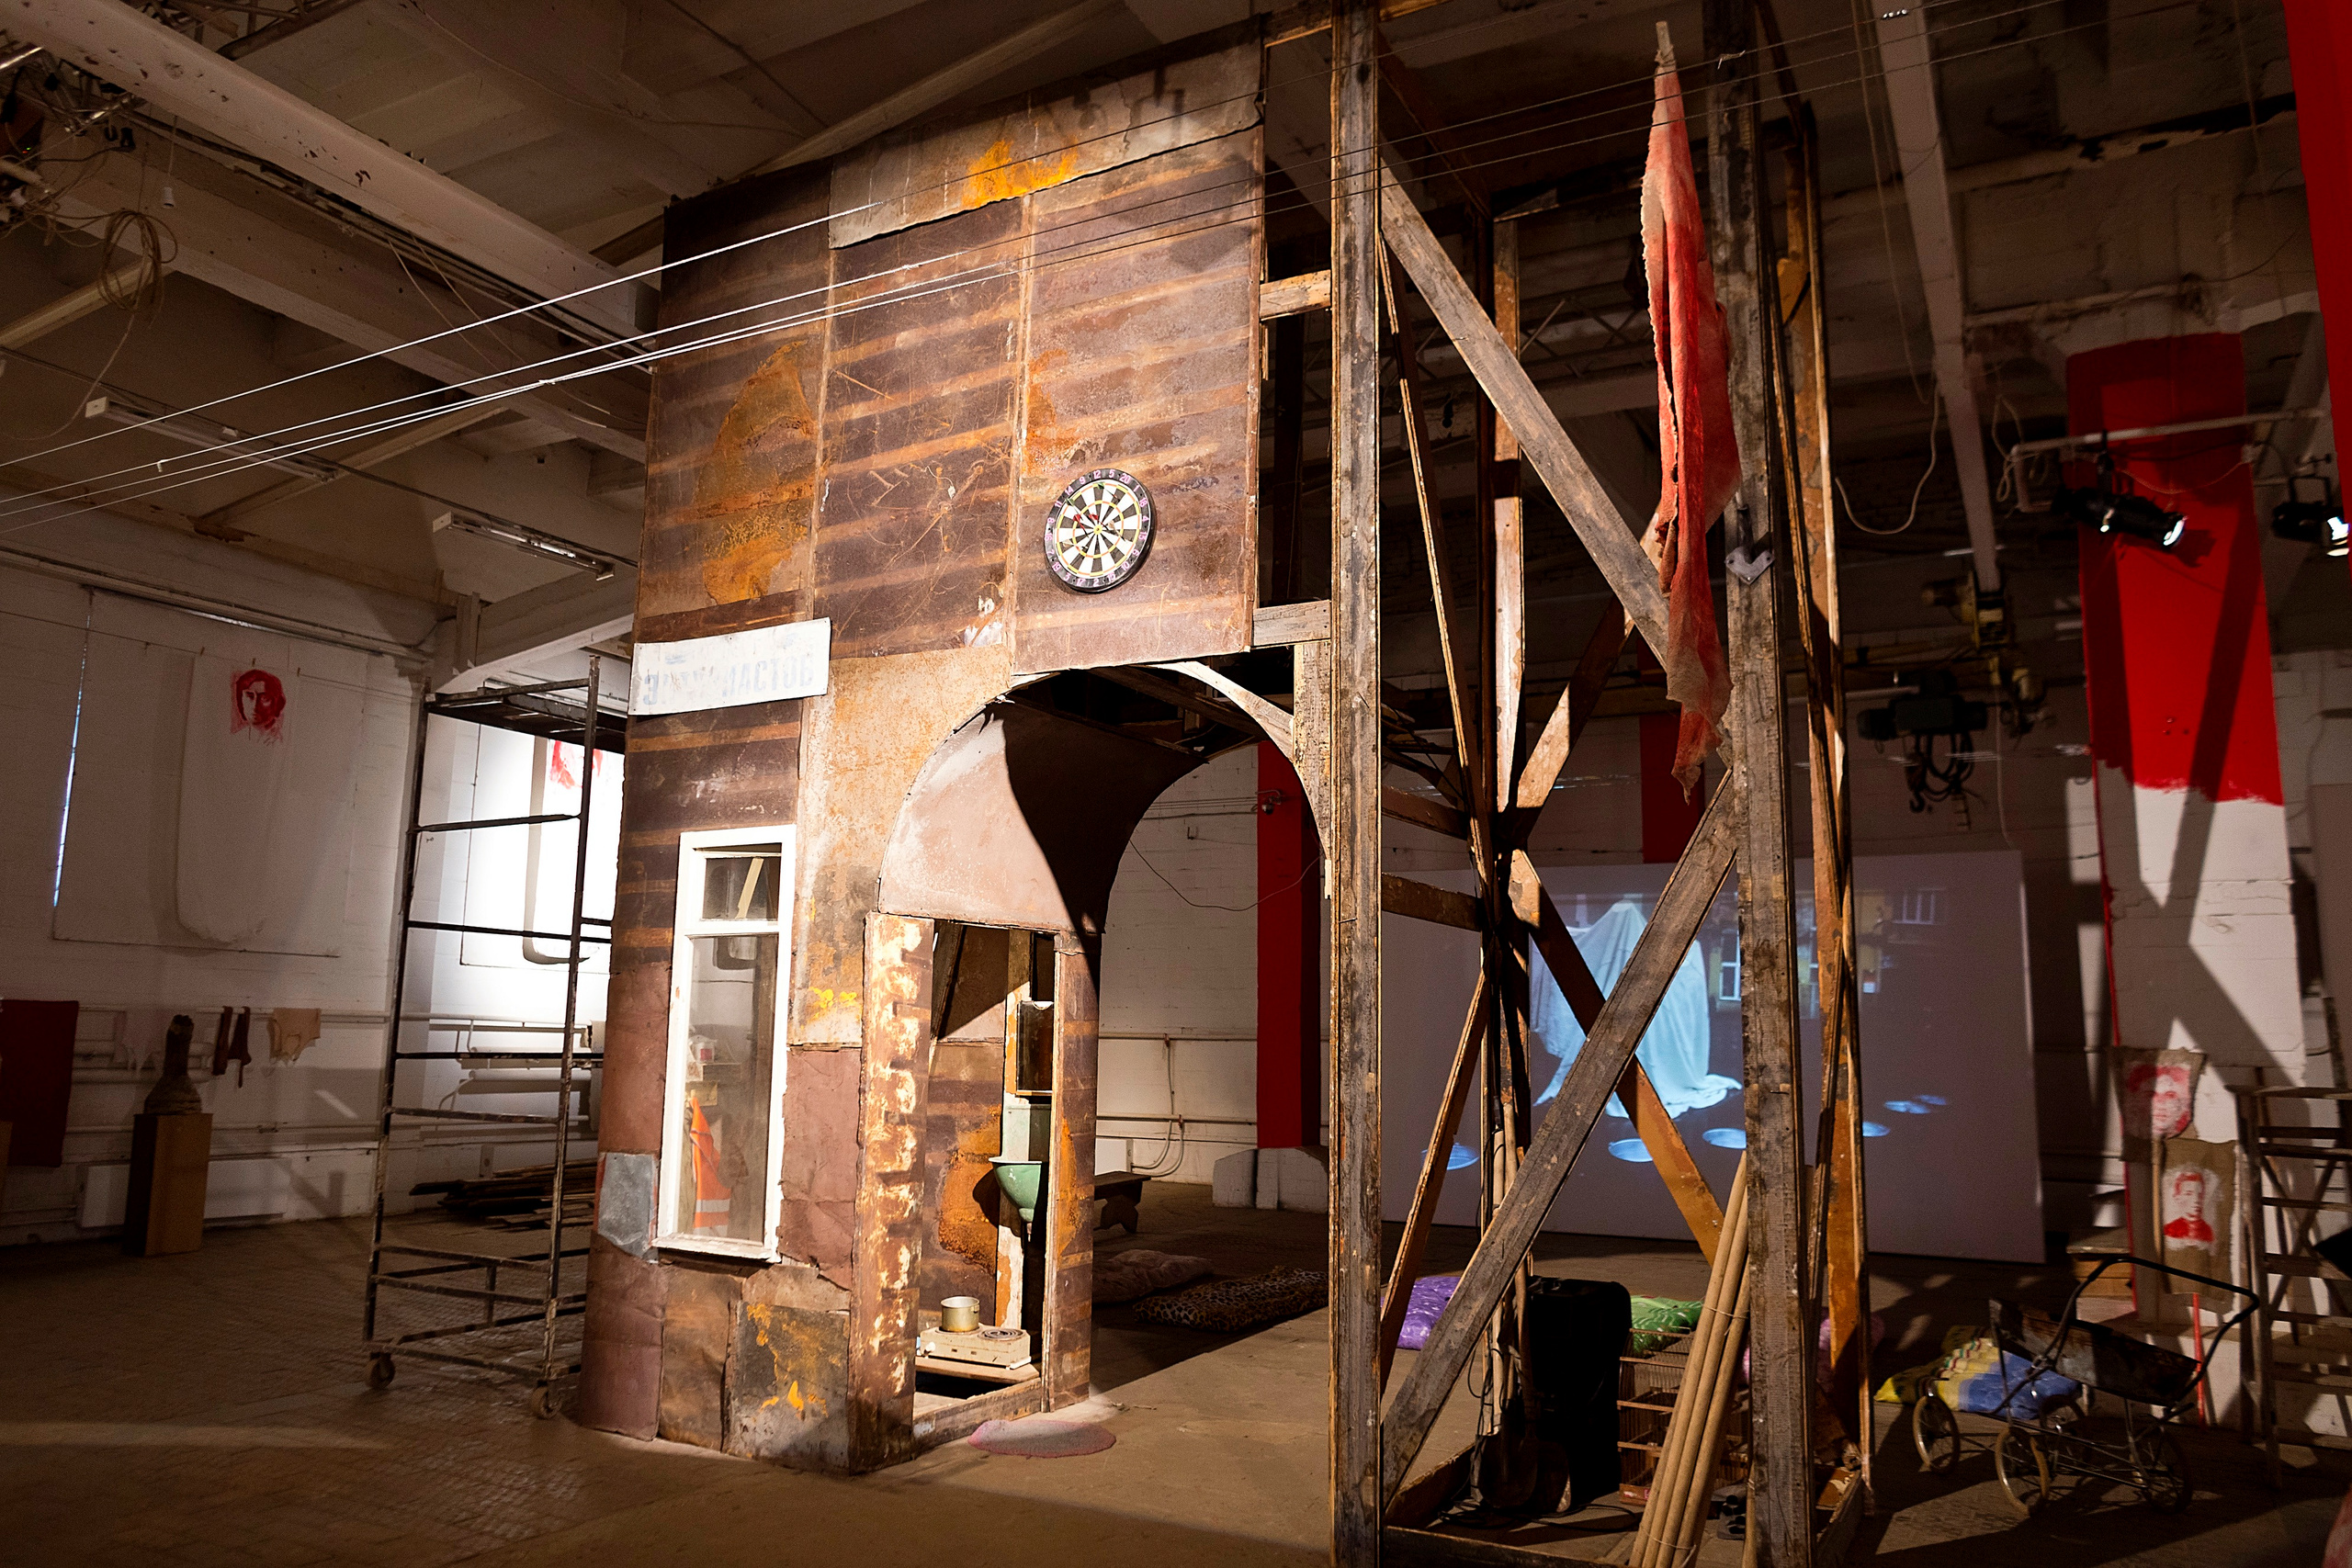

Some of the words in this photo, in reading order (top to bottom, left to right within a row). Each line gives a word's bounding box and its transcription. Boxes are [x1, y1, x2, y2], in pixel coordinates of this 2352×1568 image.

[1093, 470, 1101, 479] 12
[1109, 469, 1115, 478] 5
[1119, 473, 1131, 483] 20
[1079, 476, 1086, 484] 9
[1065, 486, 1074, 495] 14
[1055, 500, 1063, 508] 11
[1139, 498, 1148, 507] 18
[1121, 561, 1130, 571] 10
[1064, 573, 1071, 581] 3
